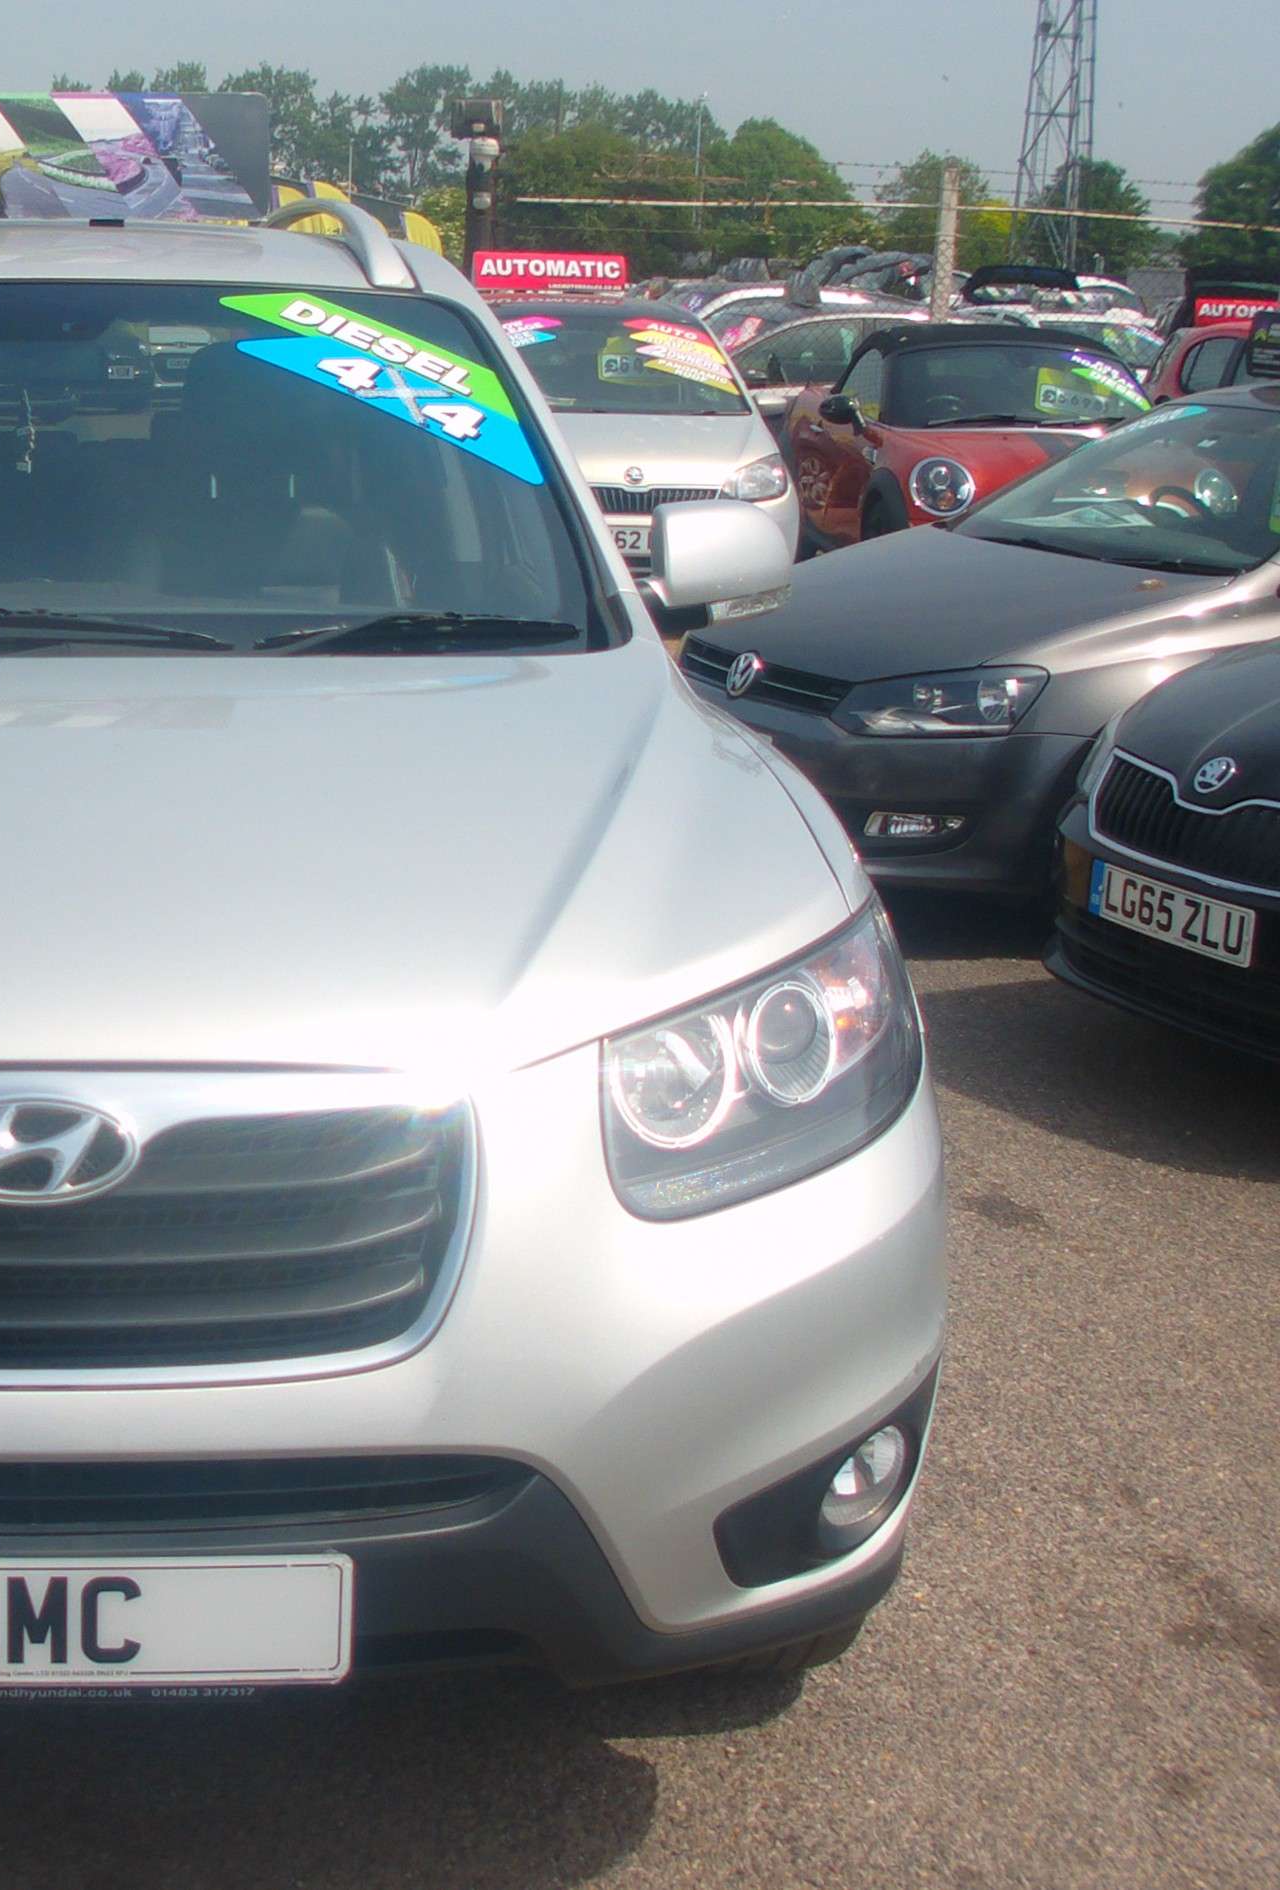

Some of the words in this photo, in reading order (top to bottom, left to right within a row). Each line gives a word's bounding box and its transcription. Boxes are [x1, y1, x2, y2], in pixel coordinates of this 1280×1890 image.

[480, 258, 621, 279] AUTOMATIC
[1198, 303, 1276, 318] AUTOM
[646, 322, 698, 341] AUTO
[279, 299, 473, 396] DIESEL
[611, 530, 641, 550] 62
[1104, 870, 1175, 933] LG65
[1180, 898, 1246, 956] ZLU
